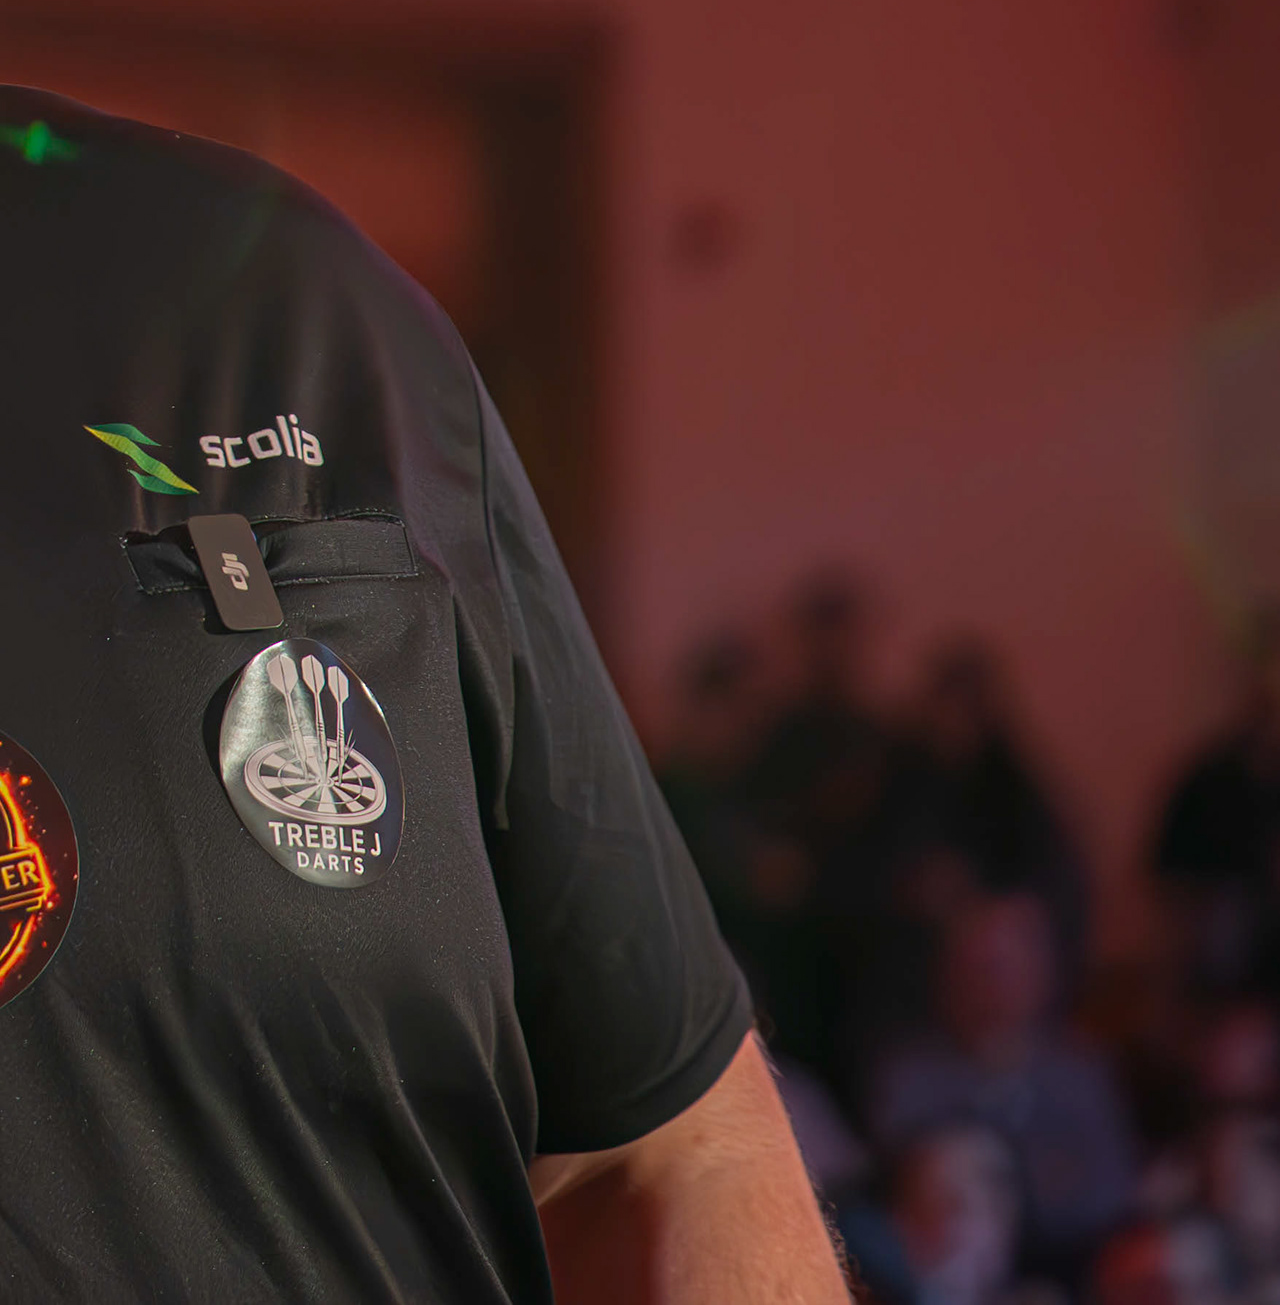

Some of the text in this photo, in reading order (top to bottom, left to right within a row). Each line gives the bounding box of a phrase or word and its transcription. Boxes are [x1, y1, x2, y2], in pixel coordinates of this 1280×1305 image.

[199, 414, 324, 468] scolia
[268, 821, 381, 856] TREBLE J
[296, 851, 365, 875] DARTS
